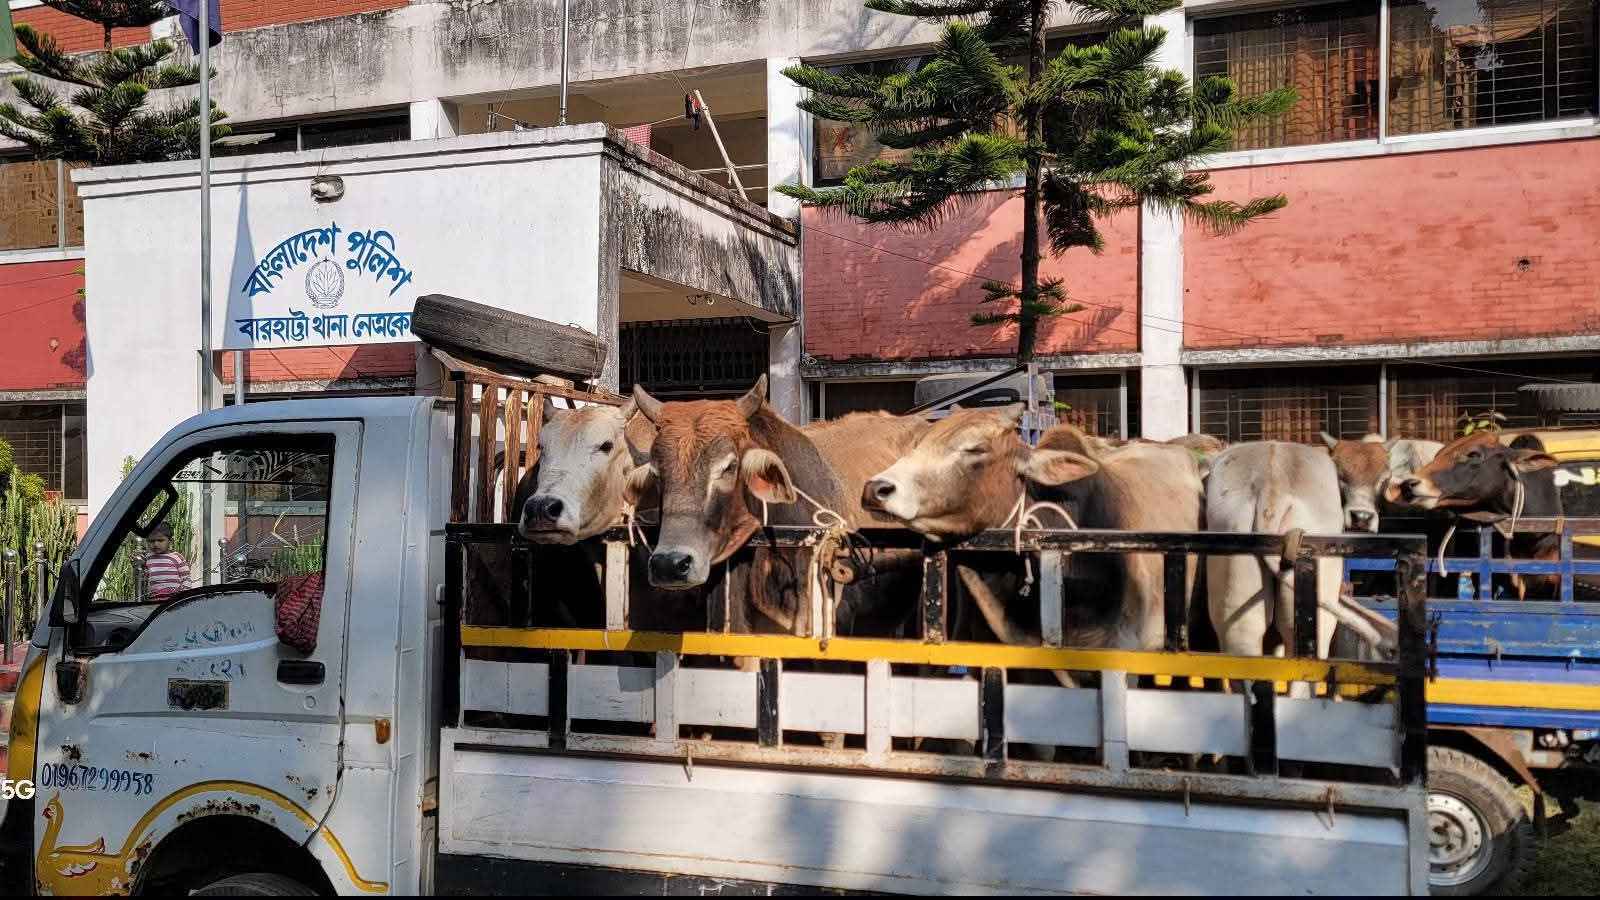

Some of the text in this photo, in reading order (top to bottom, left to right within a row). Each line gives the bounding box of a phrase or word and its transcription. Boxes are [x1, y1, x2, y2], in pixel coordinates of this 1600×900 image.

[241, 221, 412, 297] বাংলাদেশ পুলিশ
[312, 313, 348, 341] থানা
[352, 311, 415, 338] নেত্রকো
[41, 762, 153, 796] 01967299958
